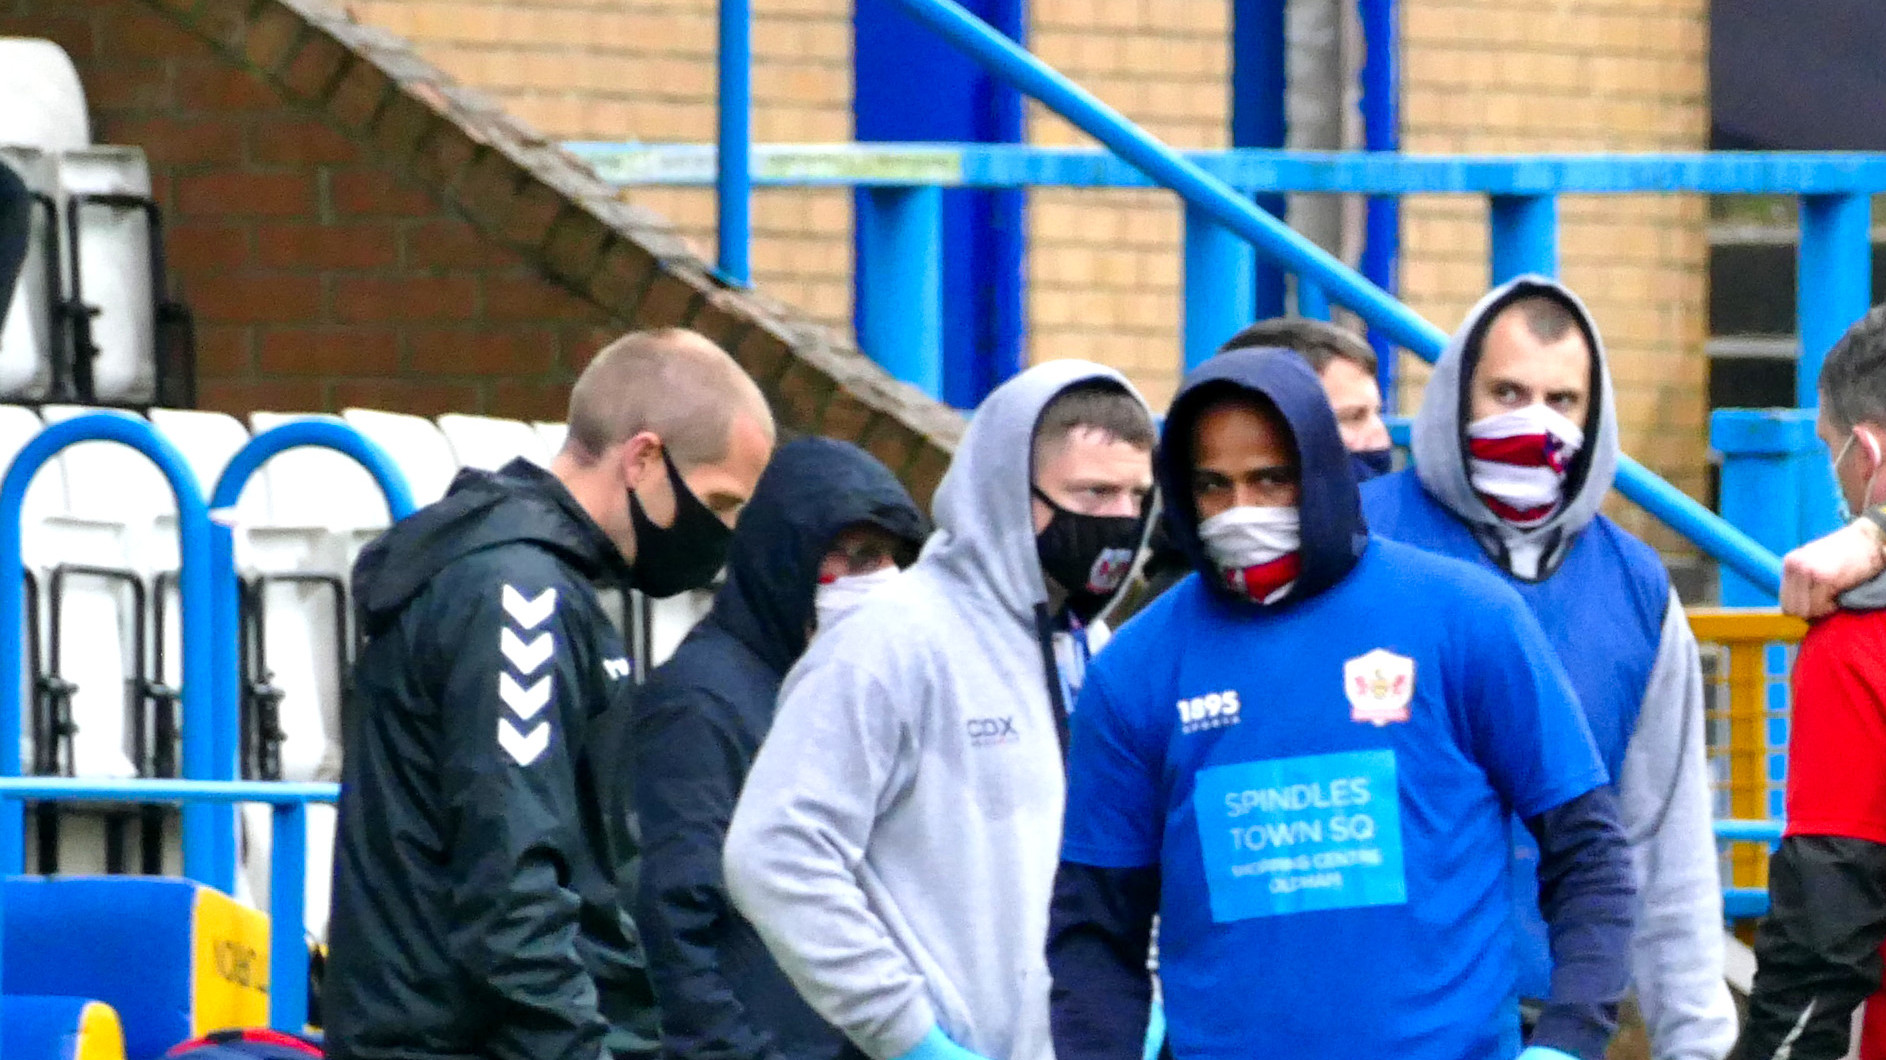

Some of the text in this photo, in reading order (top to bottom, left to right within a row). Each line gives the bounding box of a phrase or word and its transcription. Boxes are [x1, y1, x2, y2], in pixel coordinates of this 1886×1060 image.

[1177, 689, 1241, 723] 1895
[1224, 775, 1372, 819] SPINDLES
[1229, 812, 1376, 852] TOWN SQ
